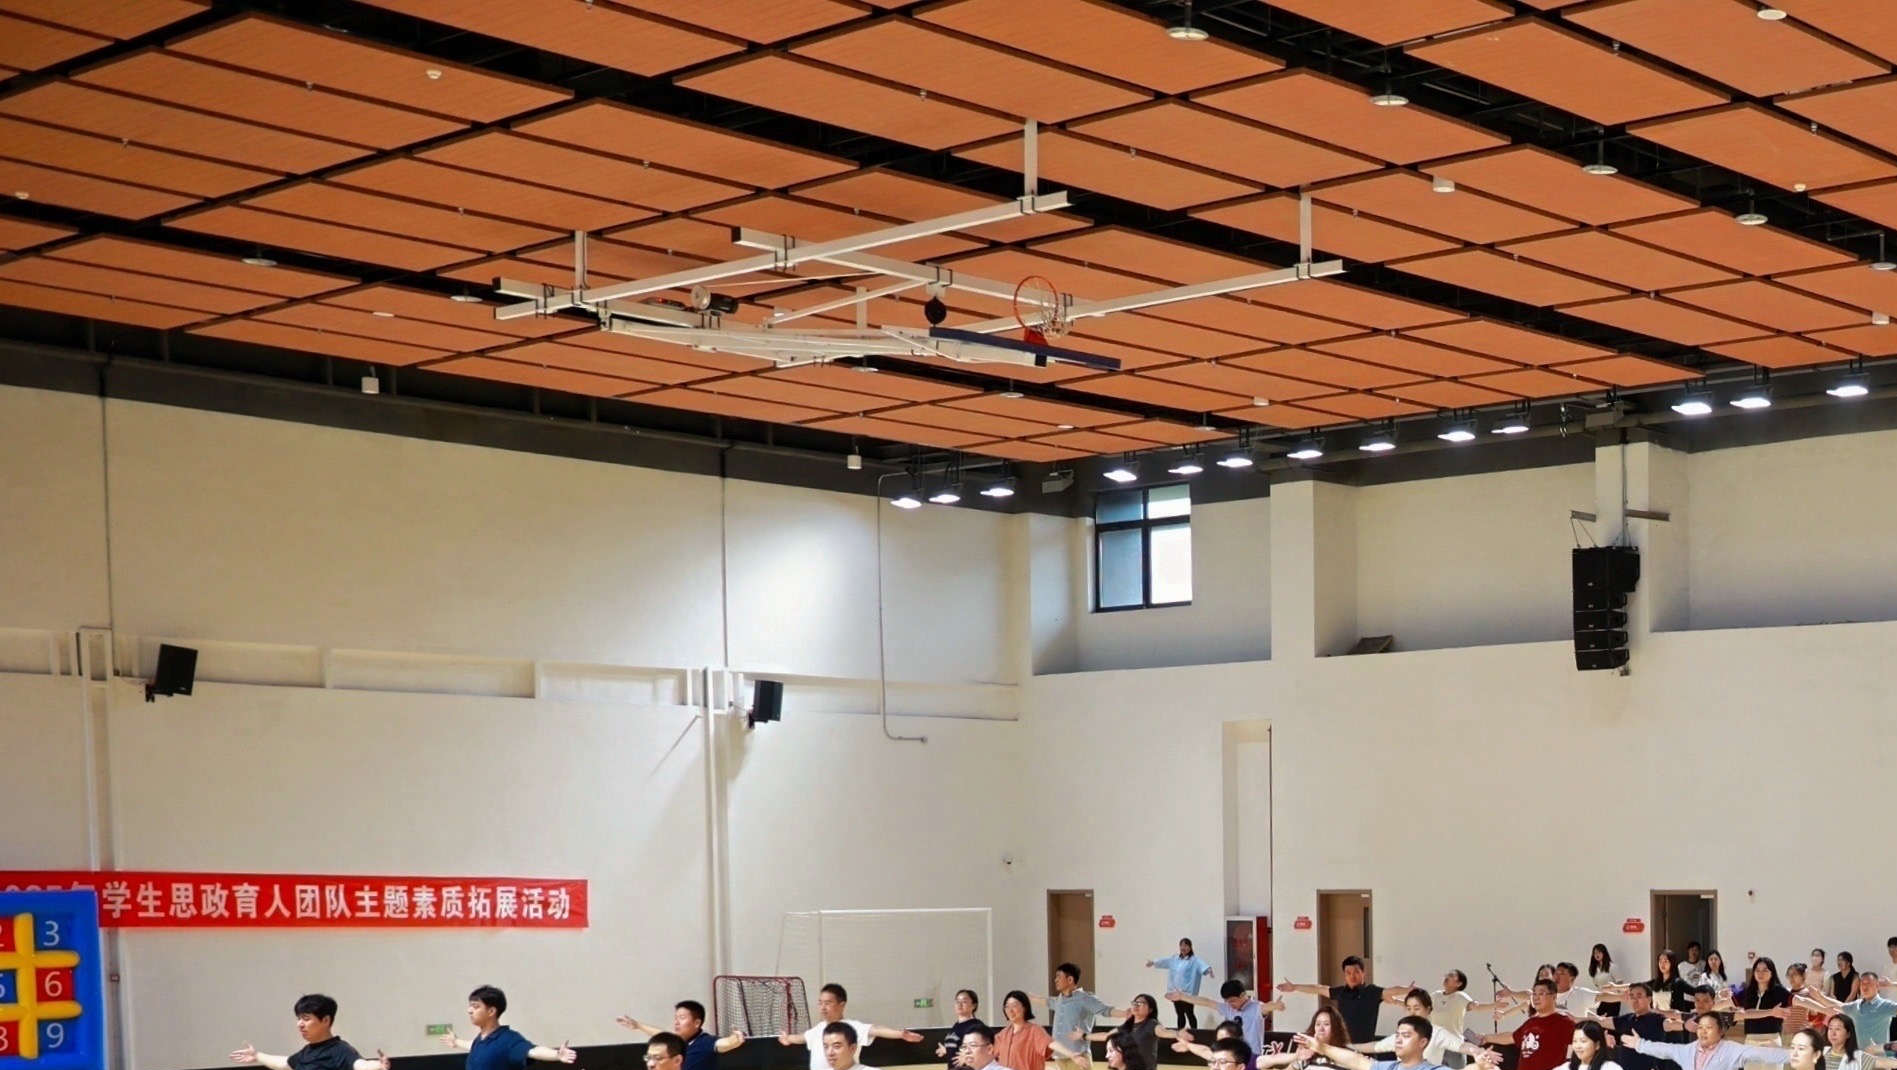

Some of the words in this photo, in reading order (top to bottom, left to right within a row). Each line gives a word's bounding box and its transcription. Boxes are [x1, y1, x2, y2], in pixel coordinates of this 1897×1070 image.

[5, 880, 570, 919] 学生思政育人团队主题素质拓展活动
[43, 920, 60, 946] 3
[44, 971, 63, 997] 6
[46, 1023, 64, 1048] 9
